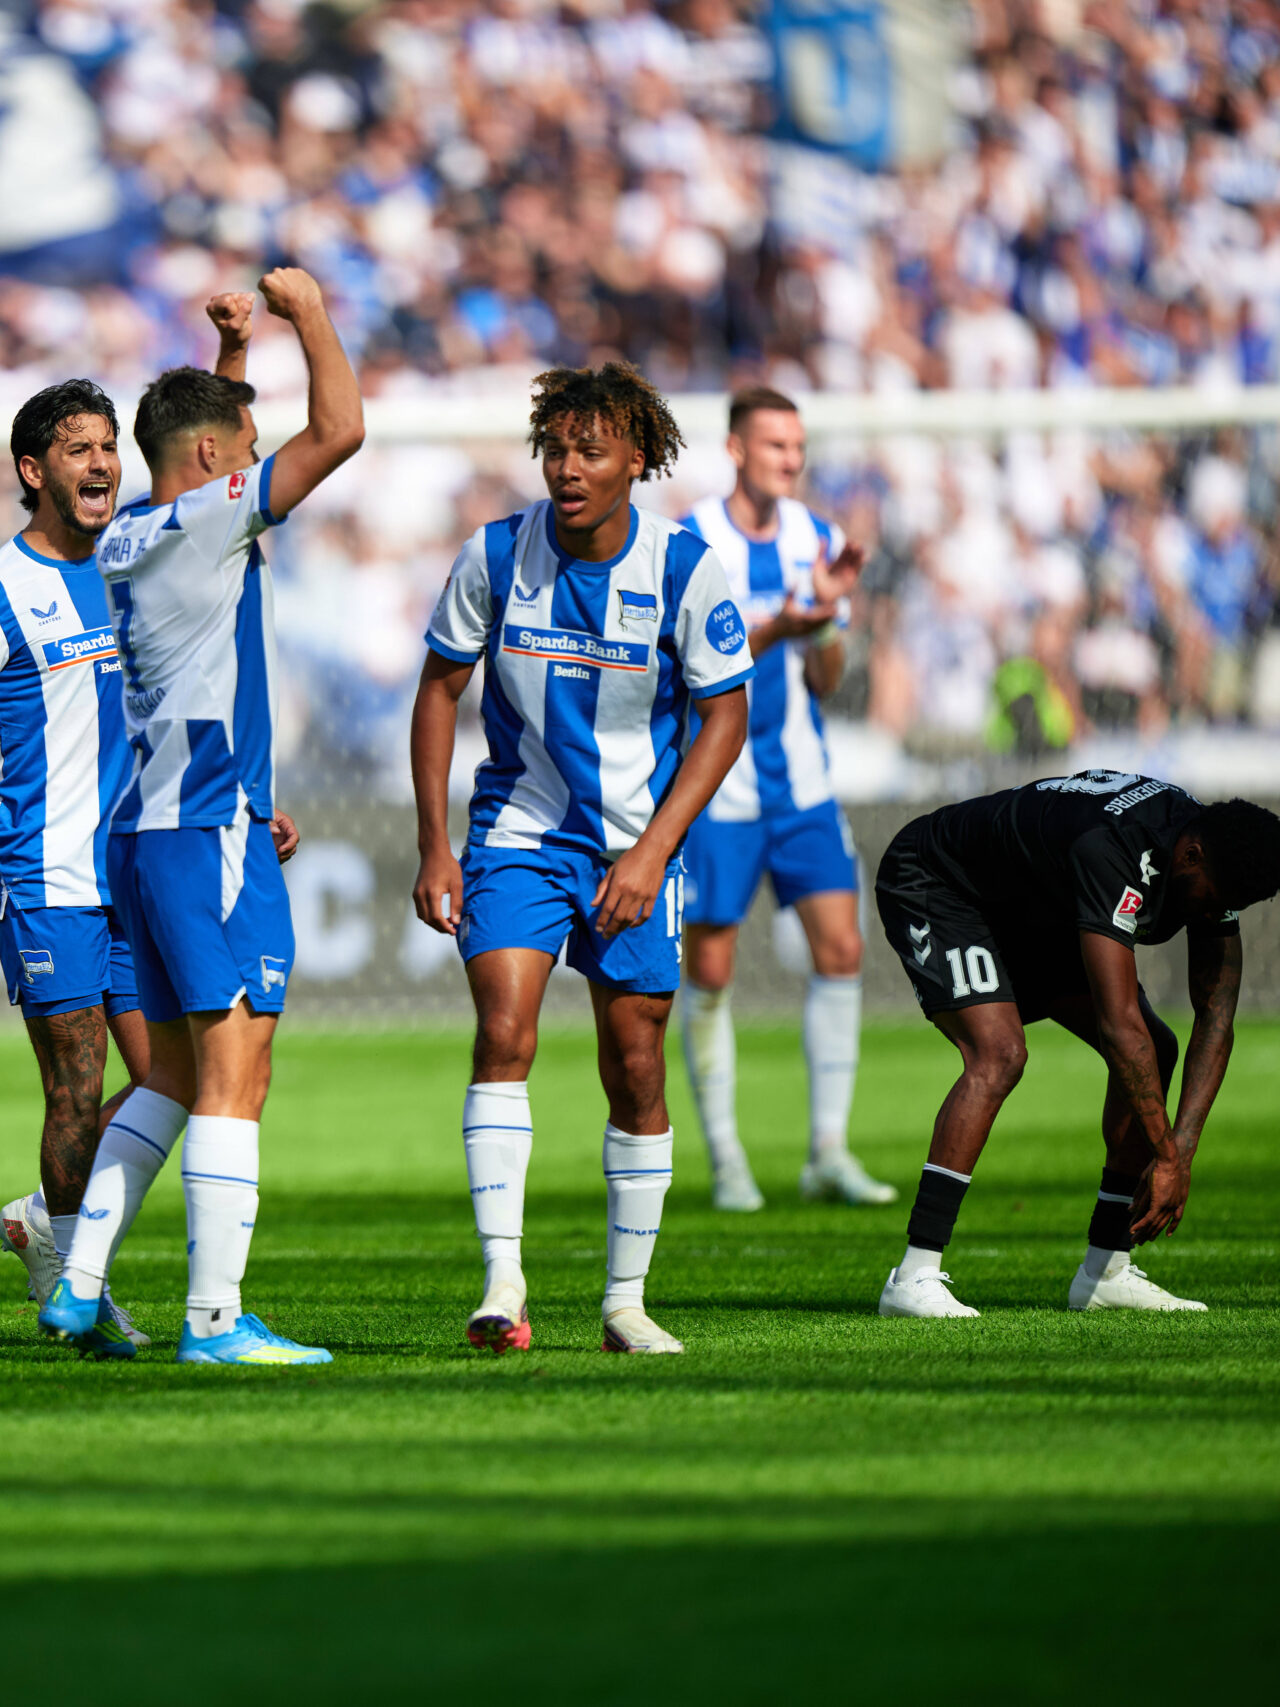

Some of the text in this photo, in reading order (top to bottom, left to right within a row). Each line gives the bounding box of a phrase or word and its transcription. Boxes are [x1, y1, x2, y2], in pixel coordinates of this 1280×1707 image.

[60, 633, 117, 658] Sparda
[519, 630, 631, 662] Sparda-Bank
[553, 664, 590, 681] Berlin
[945, 945, 1000, 999] 10
